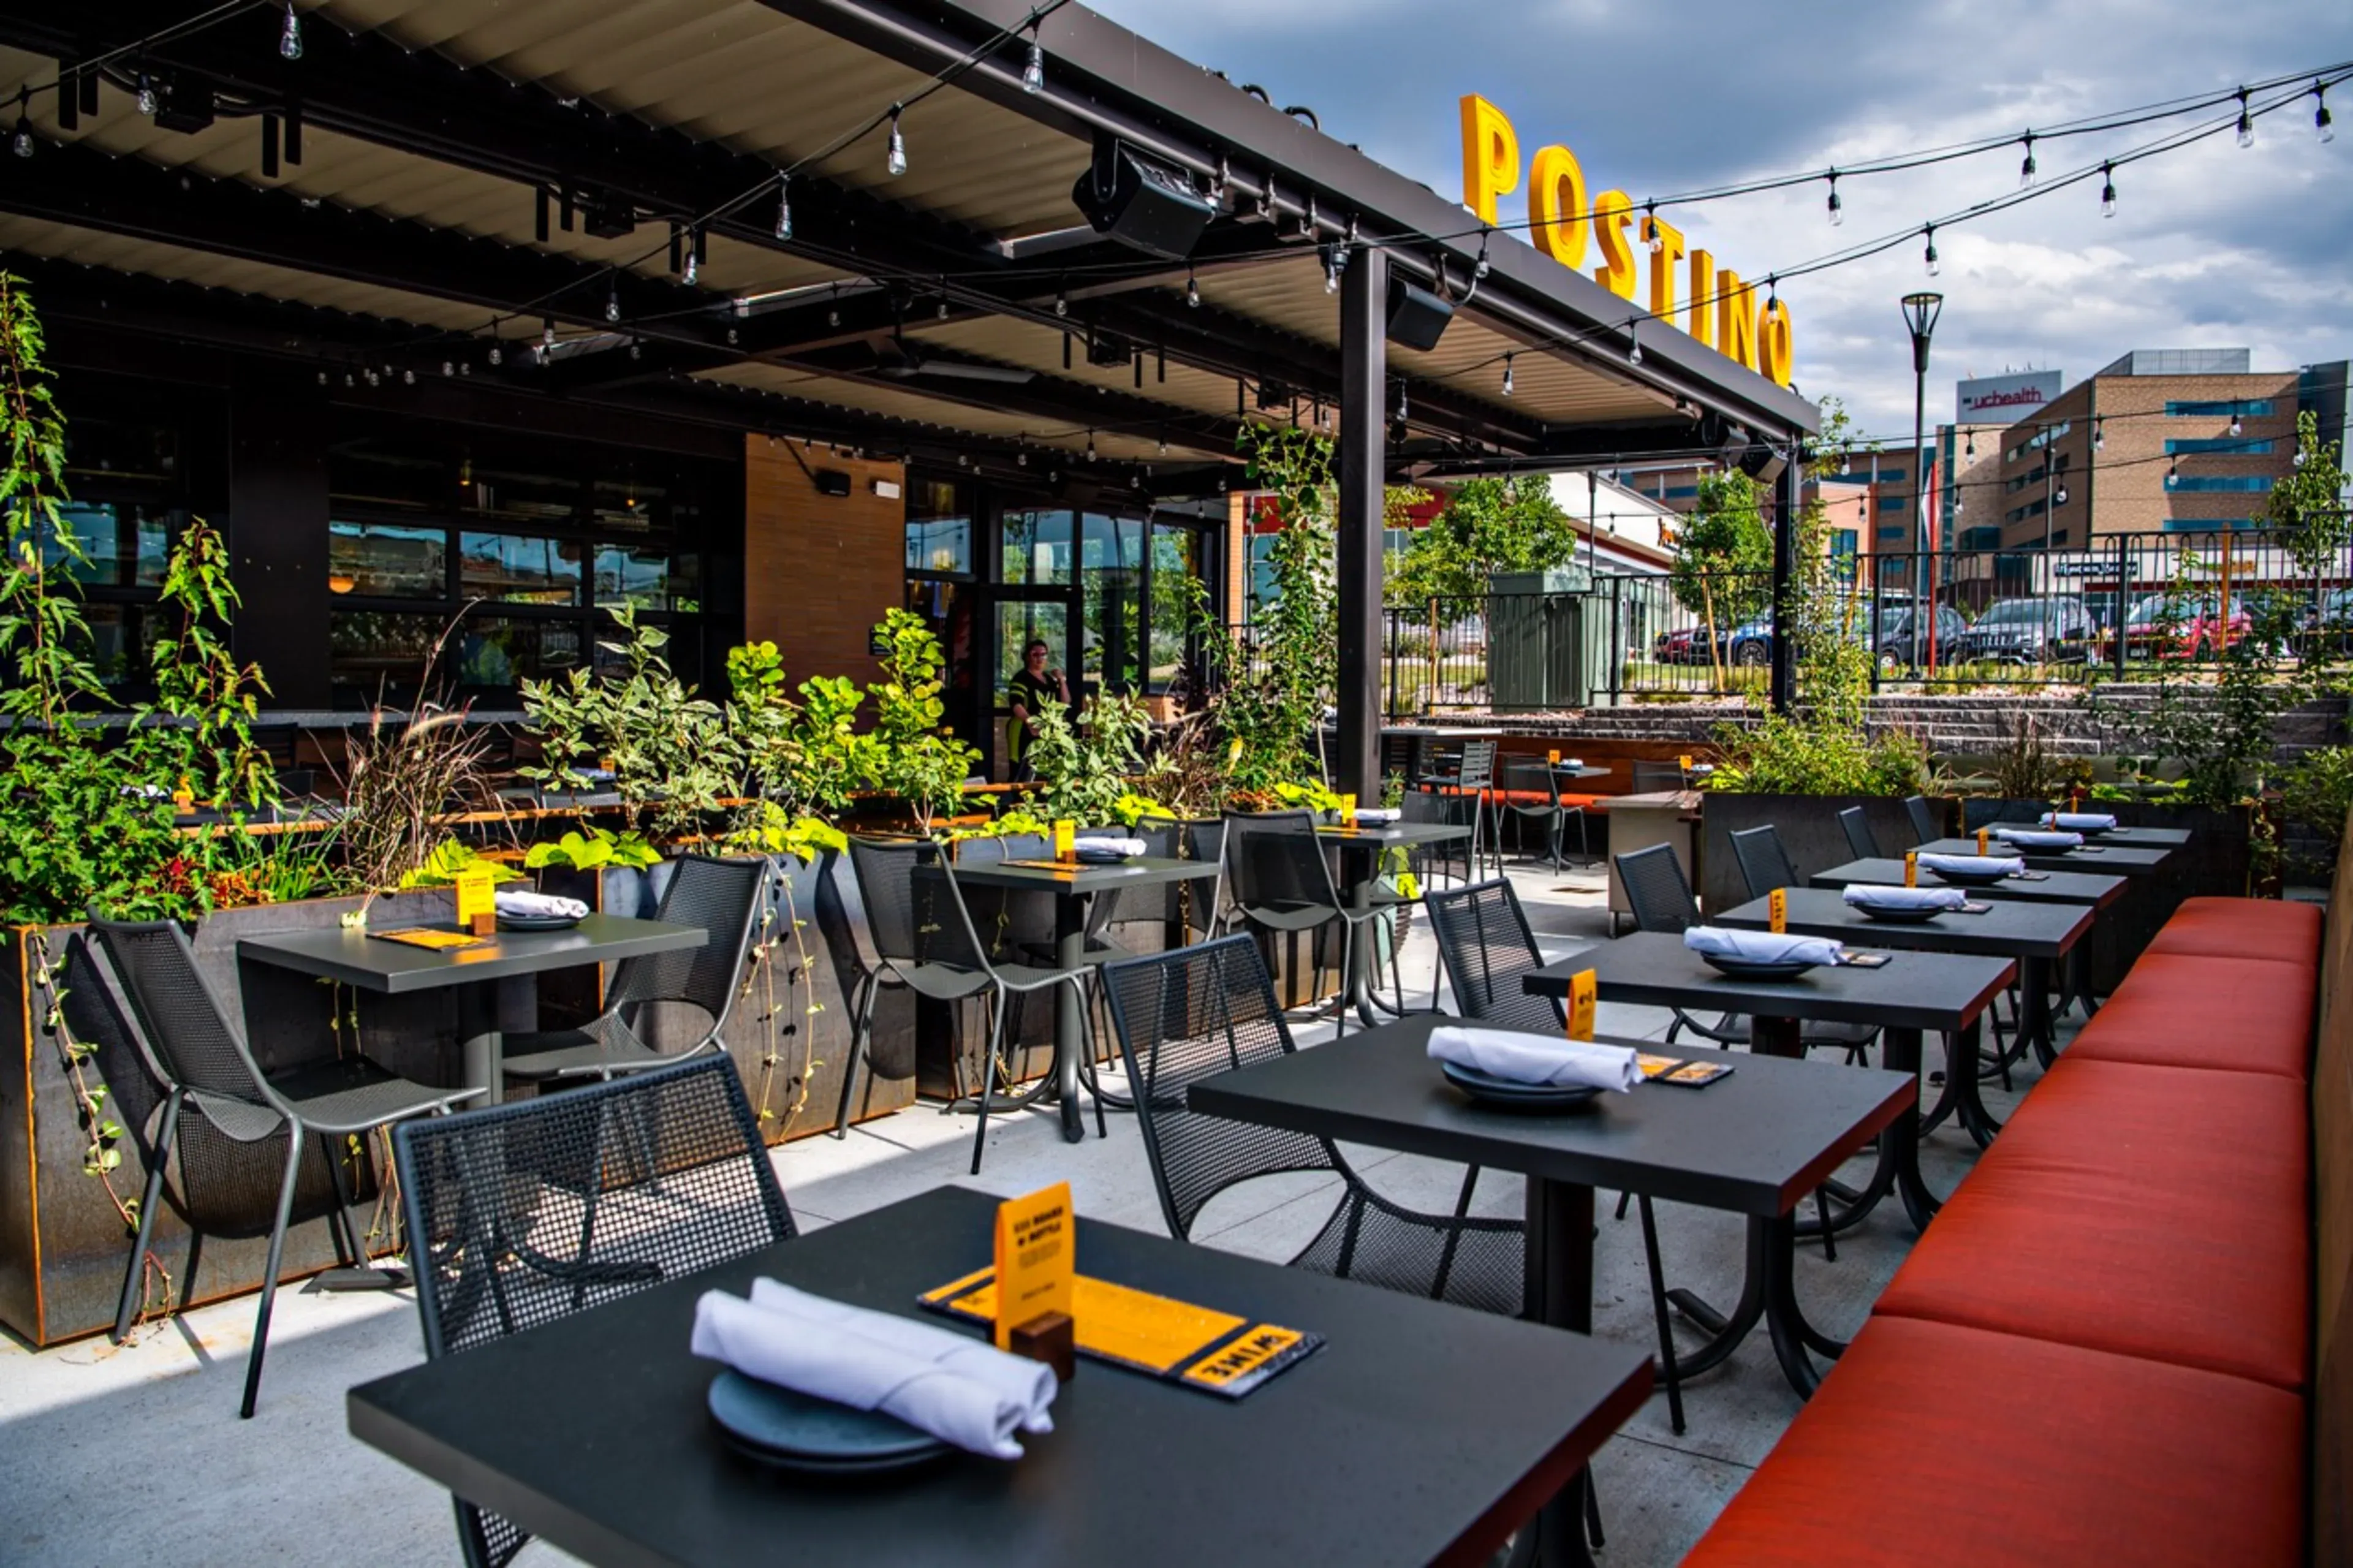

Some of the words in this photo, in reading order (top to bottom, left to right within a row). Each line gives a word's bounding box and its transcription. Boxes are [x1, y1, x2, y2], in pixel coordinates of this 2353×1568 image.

[1458, 92, 1792, 388] POSTINO
[1972, 386, 2042, 409] uchealth
[1201, 1333, 1290, 1377] WINE
